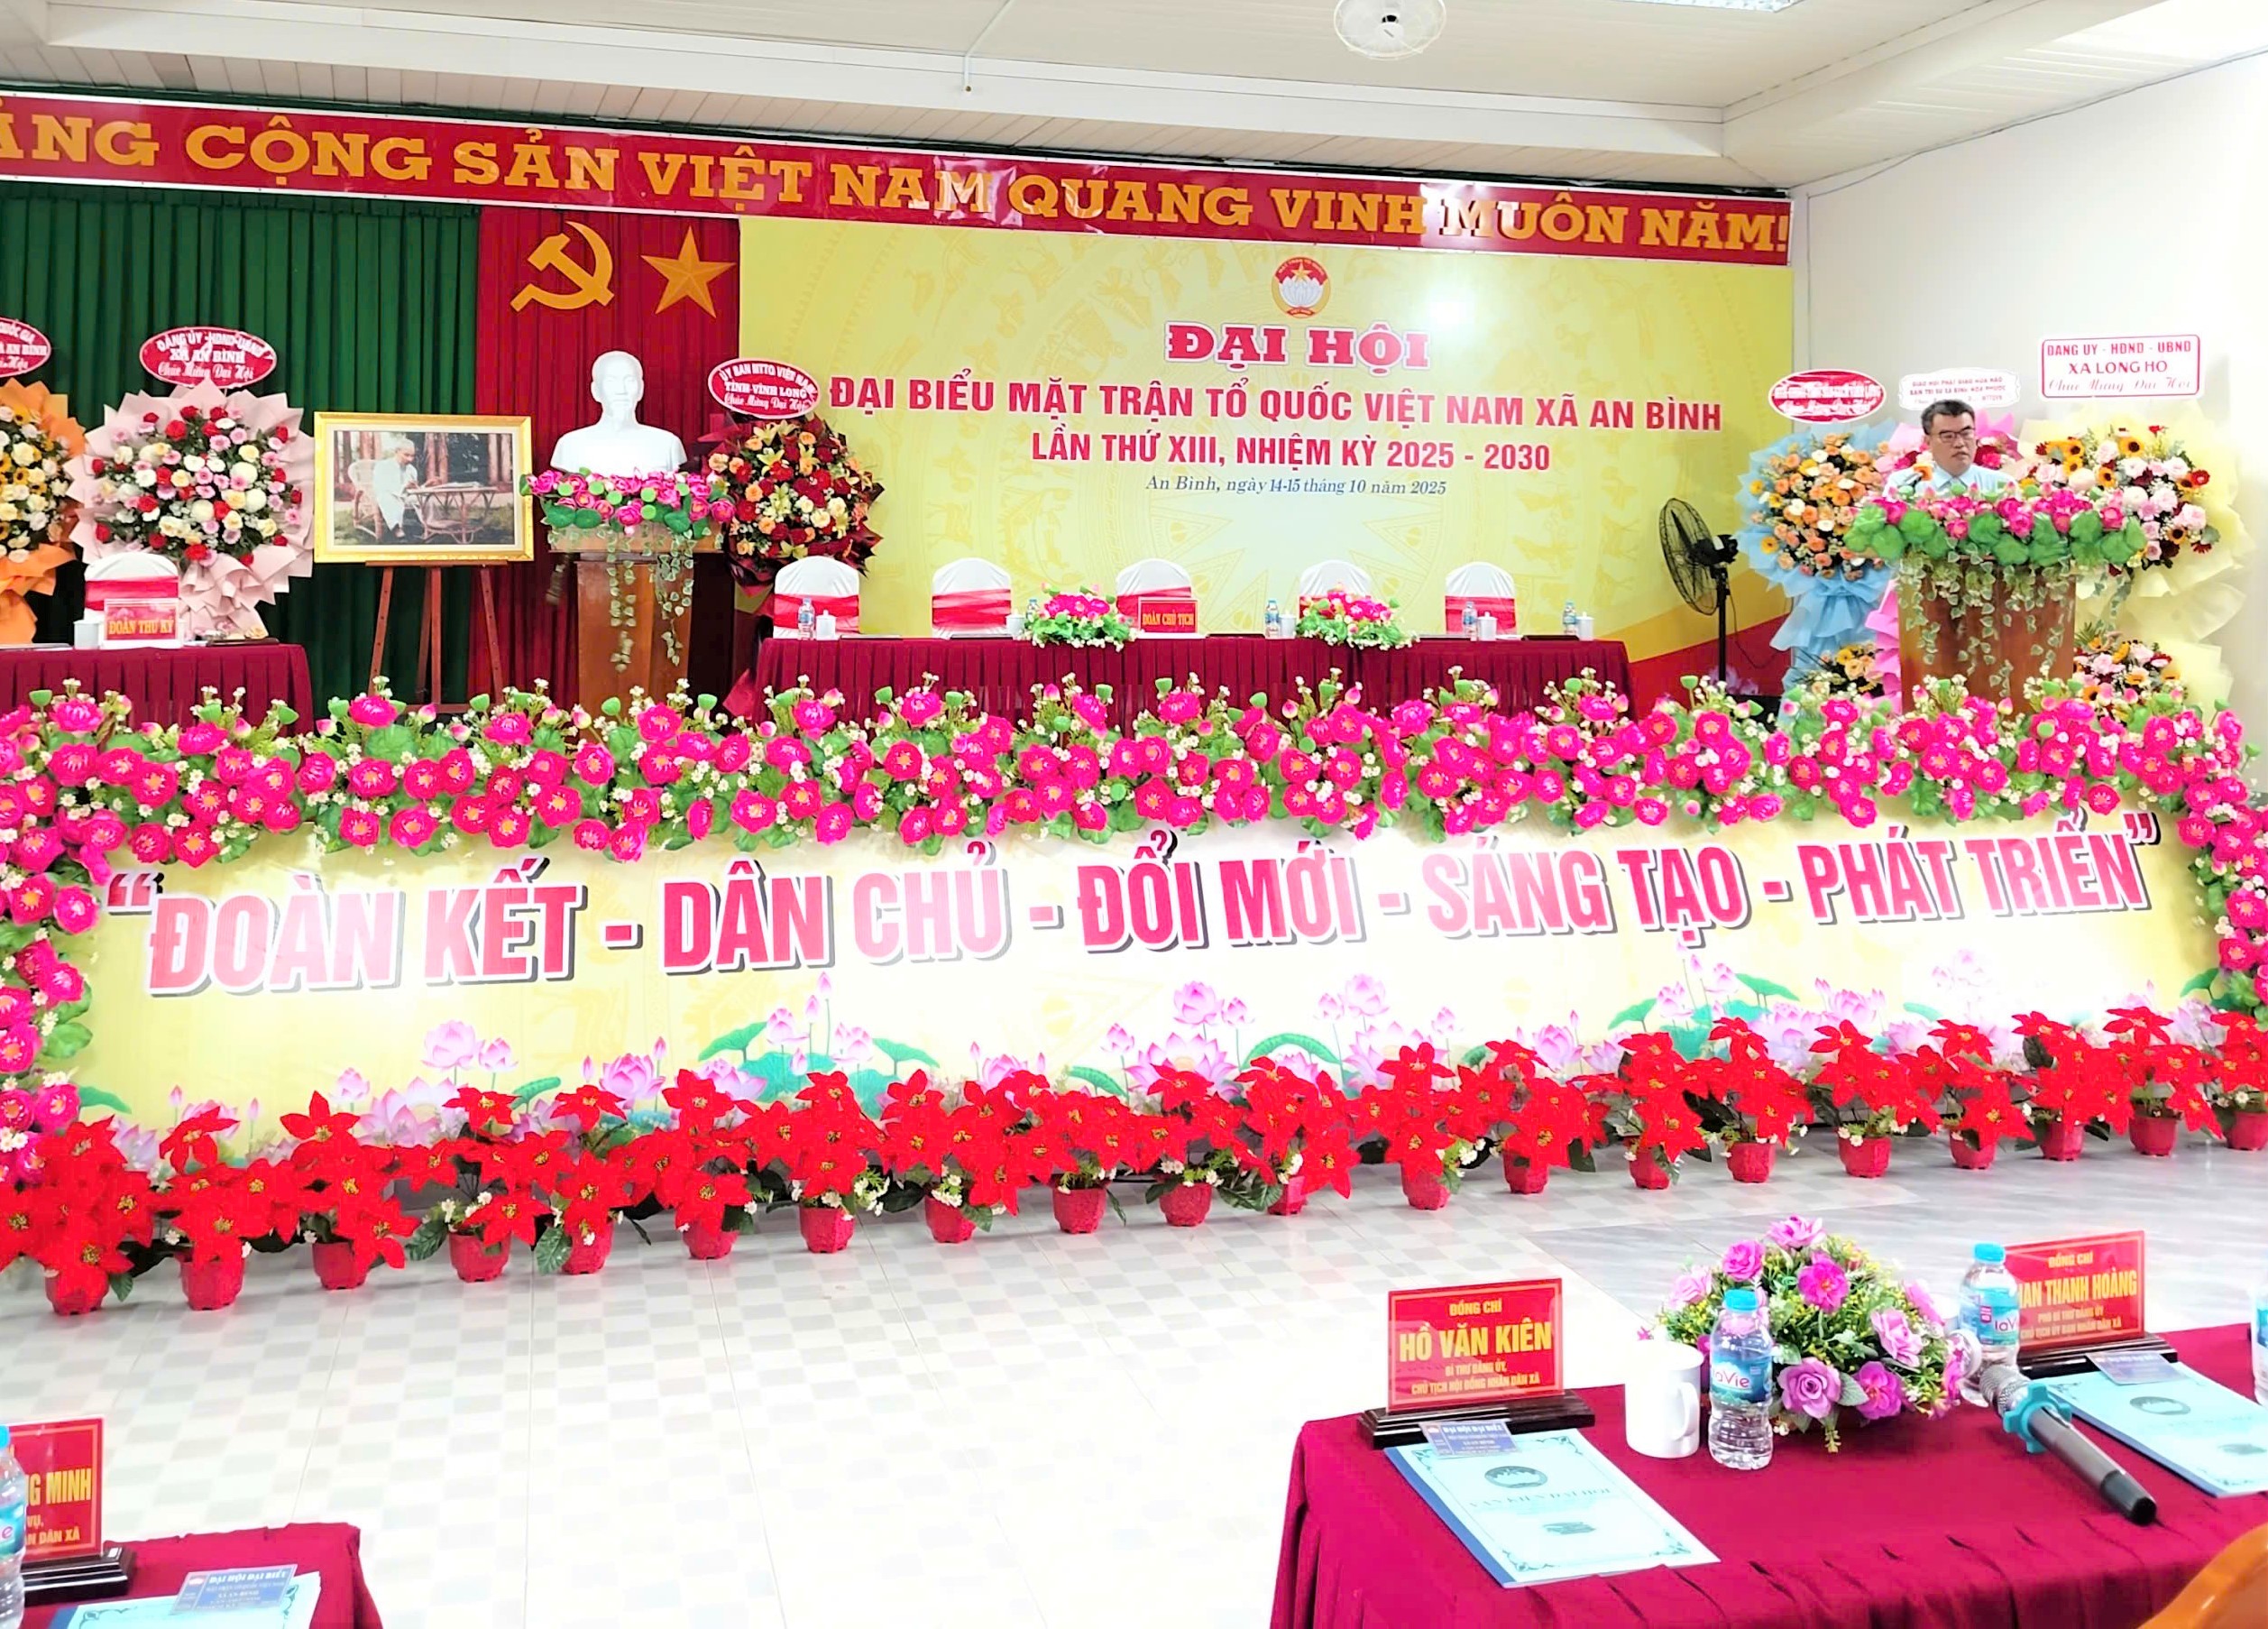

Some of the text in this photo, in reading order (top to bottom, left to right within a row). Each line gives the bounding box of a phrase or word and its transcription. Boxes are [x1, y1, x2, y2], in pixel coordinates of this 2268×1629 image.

[186, 115, 432, 185] CỘNG
[454, 128, 620, 191] SẢN
[638, 145, 812, 211] VIỆT
[830, 163, 993, 214] NAM
[1008, 174, 1253, 227] QUANG
[1270, 188, 1427, 235] VINH
[1440, 192, 1629, 244] MUÔN
[1639, 199, 1788, 252] NĂM!
[213, 348, 245, 364] BÌNH
[1169, 324, 1429, 374] ĐẠI HỘI
[732, 363, 752, 376] BAN
[2096, 361, 2141, 374] LONG
[779, 388, 807, 400] LONG
[830, 368, 1722, 431] ĐẠI BIỂU MẶT TRẬN TỔ QUỐC VIỆT NAM XÃ AN BÌNH
[1033, 423, 1090, 461] LẦN
[1101, 428, 1161, 463] THỨ
[1169, 436, 1226, 468] XIII,
[1236, 433, 1331, 471] NHIỆM
[1342, 435, 1377, 466] KỲ
[1387, 441, 1454, 469] 2025
[1484, 443, 1550, 470] 2030
[1146, 475, 1446, 496] An Bình, ngày 14-15 tháng 10 năm 2025
[109, 616, 175, 635] ĐOÀN THƯ KÝ
[427, 858, 578, 979] KẾT
[605, 925, 632, 941] -
[664, 860, 824, 969] DÂN
[853, 842, 1004, 960] CHỦ
[1029, 905, 1053, 922] -
[1077, 830, 1201, 947] ĐỔI
[1218, 840, 1353, 940] MỚI
[1378, 893, 1400, 908] -
[1421, 835, 1608, 933] SÁNG
[1616, 845, 1743, 943] TẠO
[1796, 825, 1955, 918] PHÁT
[2044, 1275, 2089, 1306] THANH
[2092, 1265, 2137, 1300] HOÀNG
[1483, 1298, 1502, 1313] CHÍ
[1400, 1317, 1553, 1363] HỒ VĂN KIÊN
[46, 1468, 92, 1505] MINH
[39, 1528, 62, 1545] DÂN
[64, 1525, 80, 1542] XÃ
